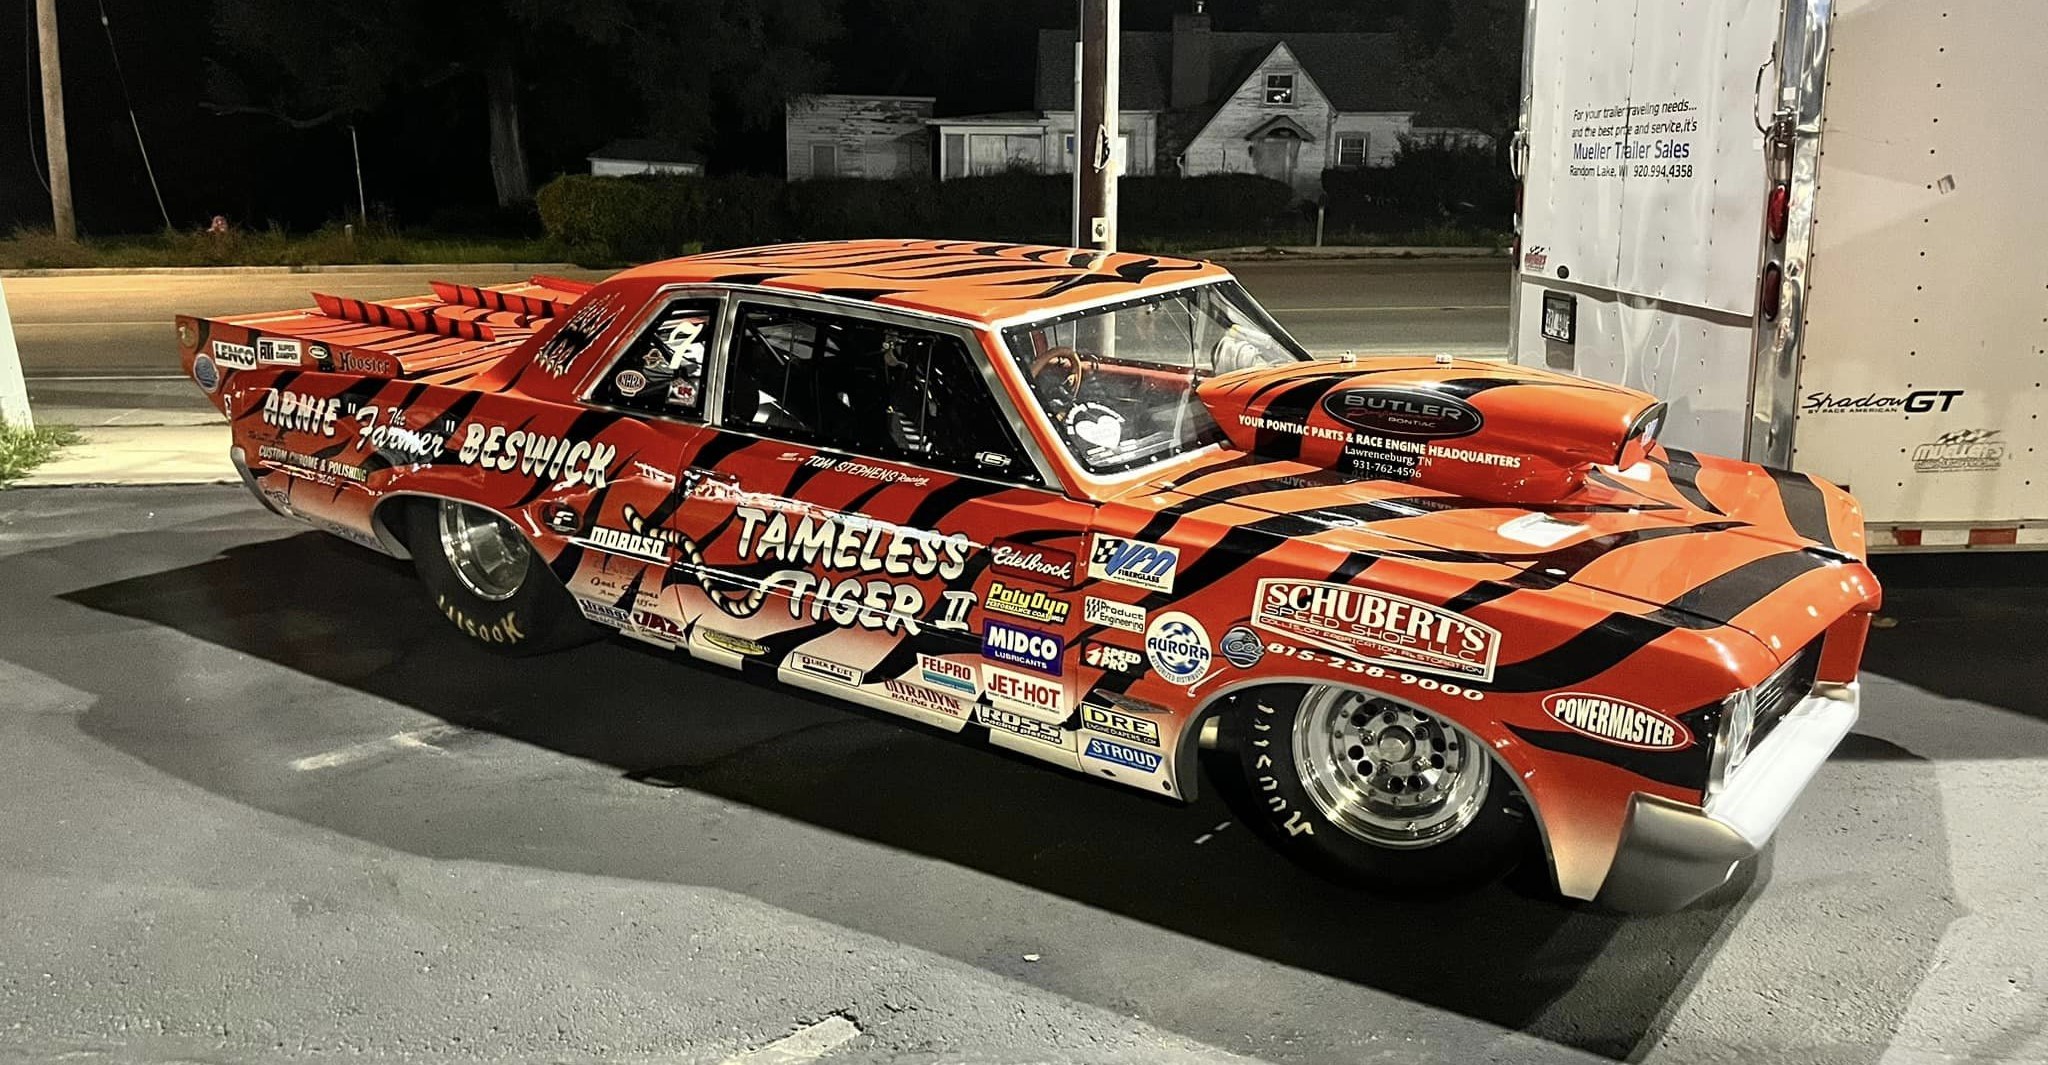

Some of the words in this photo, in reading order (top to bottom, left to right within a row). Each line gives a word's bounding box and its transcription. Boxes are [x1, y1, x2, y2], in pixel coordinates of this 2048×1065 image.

[1634, 122, 1649, 135] and
[1574, 142, 1611, 160] Mueller
[1615, 141, 1651, 160] Trailer
[1654, 139, 1690, 159] Sales
[1569, 165, 1595, 177] Random
[1633, 164, 1693, 178] 920.994.4358
[215, 343, 254, 366] LENCO
[260, 341, 274, 360] ATI
[339, 349, 390, 374] Hoosier
[619, 373, 641, 389] NHRA
[1344, 394, 1463, 421] BUTLER
[1802, 391, 1909, 411] Shadow
[1904, 390, 1965, 414] GT
[386, 406, 407, 426] The
[1388, 416, 1437, 428] PONTIAC
[262, 388, 341, 437] ARNIE
[459, 423, 617, 491] BESWICK
[1238, 414, 1265, 428] YOUR
[1266, 420, 1310, 436] PONTIAC
[1311, 426, 1344, 442] PARTS
[1345, 432, 1354, 443] &
[1355, 433, 1383, 448] RACE
[1385, 438, 1426, 455] ENGINE
[1428, 444, 1521, 468] HEADQUARTERS
[259, 445, 288, 461] CUSTOM
[288, 451, 319, 469] CHROME
[319, 459, 326, 472] &
[327, 461, 367, 482] POLISHING
[805, 456, 835, 469] TOM
[834, 462, 896, 482] STEPHENS
[896, 474, 930, 487] Racing
[1352, 459, 1422, 478] 931-762-4596
[1417, 456, 1433, 467] TN
[591, 526, 668, 560] MOROSO
[737, 506, 969, 580] TAMELESS
[994, 546, 1071, 580] Edelbrock
[1118, 569, 1160, 583] FIBERGLASS
[761, 570, 923, 636] TIGER
[935, 590, 977, 631] II
[986, 600, 1031, 616] PERFORMANCE
[989, 583, 1069, 620] PolyDyn
[1100, 601, 1144, 620] Product
[1100, 612, 1143, 632] Engineering
[1265, 604, 1340, 629] SPEED
[1350, 623, 1417, 645] SHOP
[1267, 584, 1486, 651] SCHUBERT'S
[987, 626, 1057, 660] MIDCO
[1103, 646, 1141, 664] SPEED
[1148, 637, 1209, 660] AURORA
[1261, 617, 1319, 636] COLLISION
[1323, 632, 1397, 655] FABRICATION
[1400, 648, 1483, 675] RESTORATION
[922, 656, 971, 681] FEL-PRO
[994, 650, 1047, 669] LUBRICANTS
[1100, 656, 1128, 672] PRO
[1267, 642, 1484, 700] 815-238-9000
[884, 678, 962, 711] ULTRADYNE
[988, 673, 1060, 708] JET-HOT
[892, 693, 927, 707] RACING
[931, 702, 958, 716] CAMS
[981, 706, 1060, 738] ROSS
[981, 718, 1018, 734] racing
[1019, 727, 1062, 744] pistons
[1090, 708, 1150, 737] DRE
[1555, 698, 1675, 746] POWERMASTER
[1092, 740, 1157, 768] STROUD
